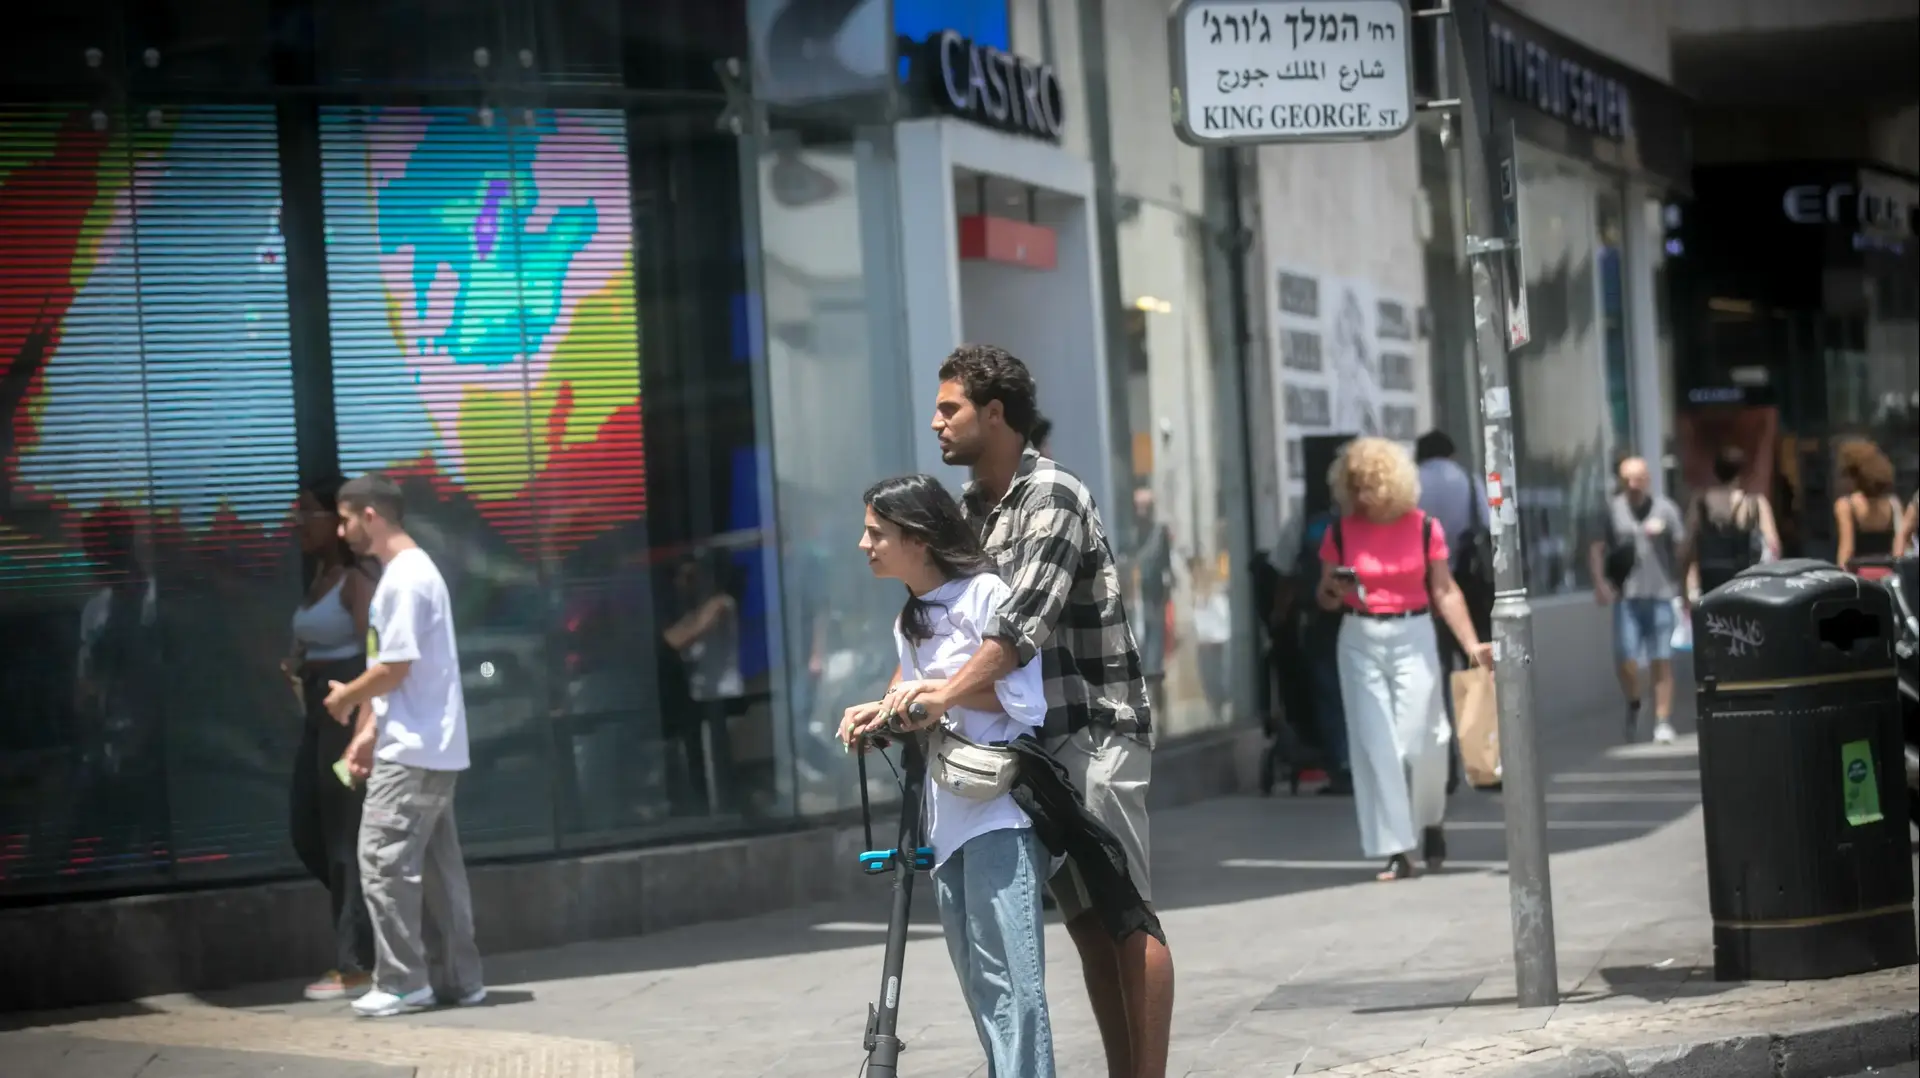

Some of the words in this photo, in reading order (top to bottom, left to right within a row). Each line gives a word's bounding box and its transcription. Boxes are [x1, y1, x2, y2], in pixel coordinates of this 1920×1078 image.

[1284, 7, 1358, 49] המלך
[940, 28, 1063, 138] CASTRO
[1217, 68, 1269, 93] جورج
[1277, 62, 1326, 81] الملك
[1338, 60, 1385, 91] شارع
[1203, 105, 1263, 130] KING
[1270, 104, 1371, 128] GEORGE
[1378, 110, 1402, 126] ST.
